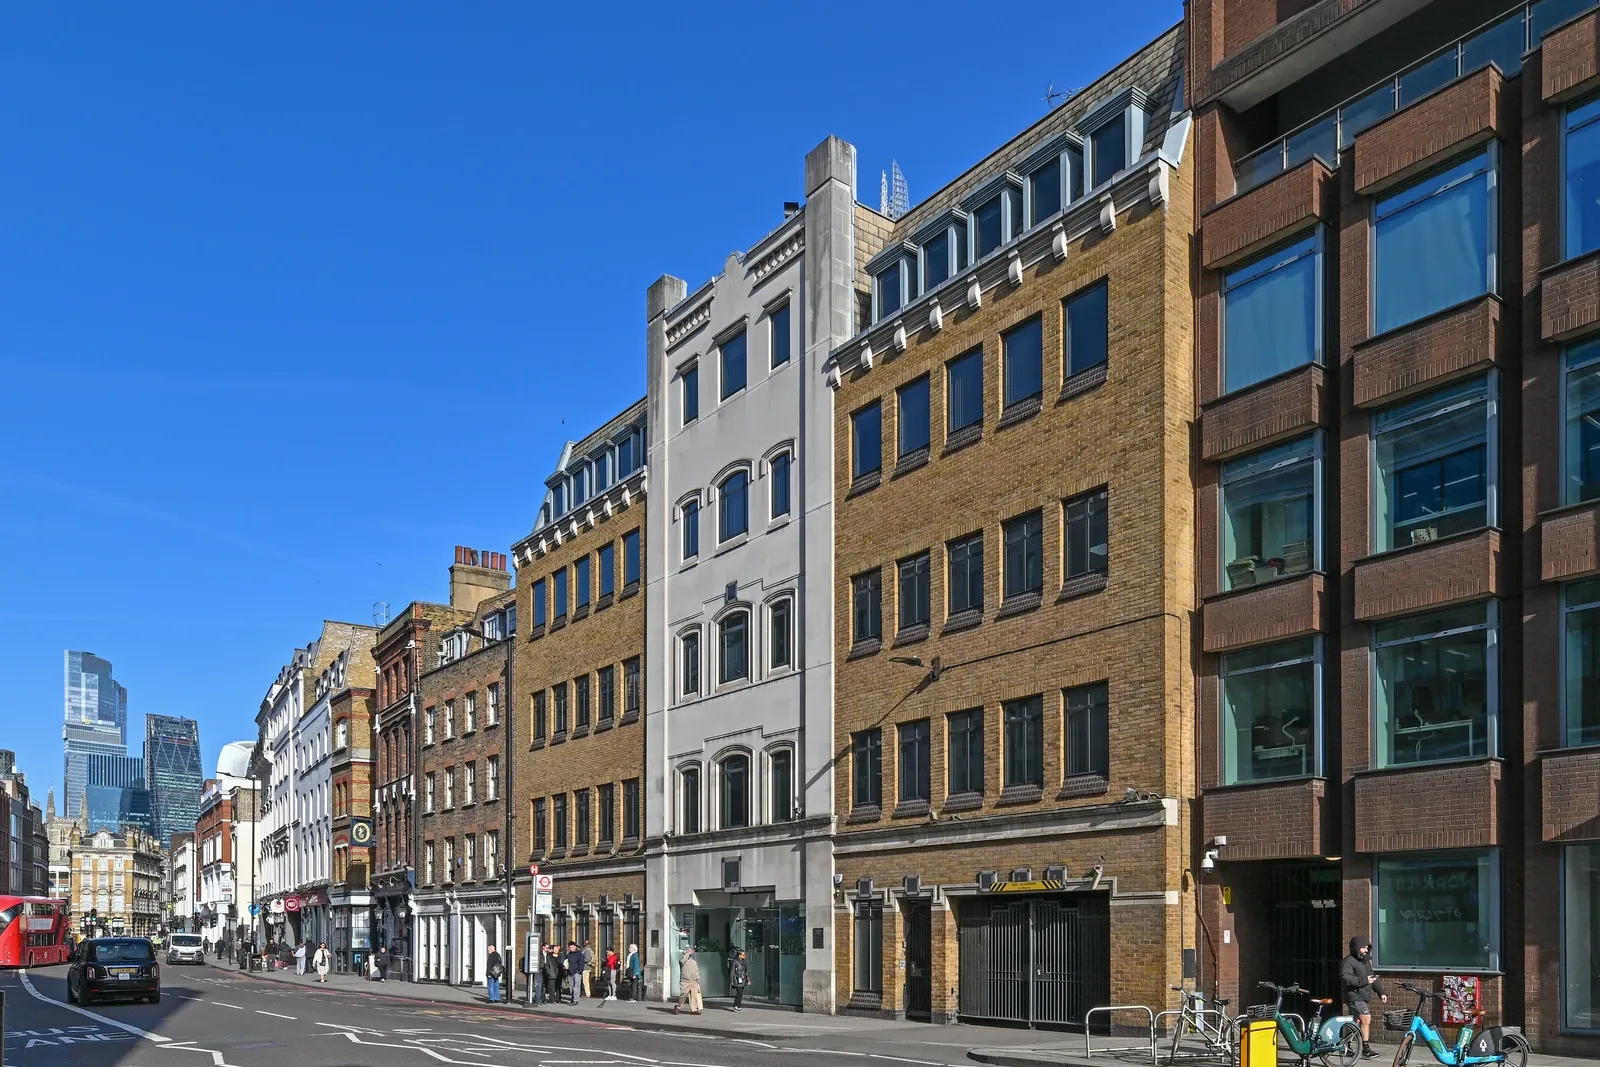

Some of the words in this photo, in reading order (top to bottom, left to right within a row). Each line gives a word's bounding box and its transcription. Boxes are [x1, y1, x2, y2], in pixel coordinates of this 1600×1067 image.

[466, 898, 482, 908] DELTA
[483, 897, 501, 907] HOUSE
[4, 1031, 137, 1049] ANE
[1459, 1030, 1470, 1048] forest
